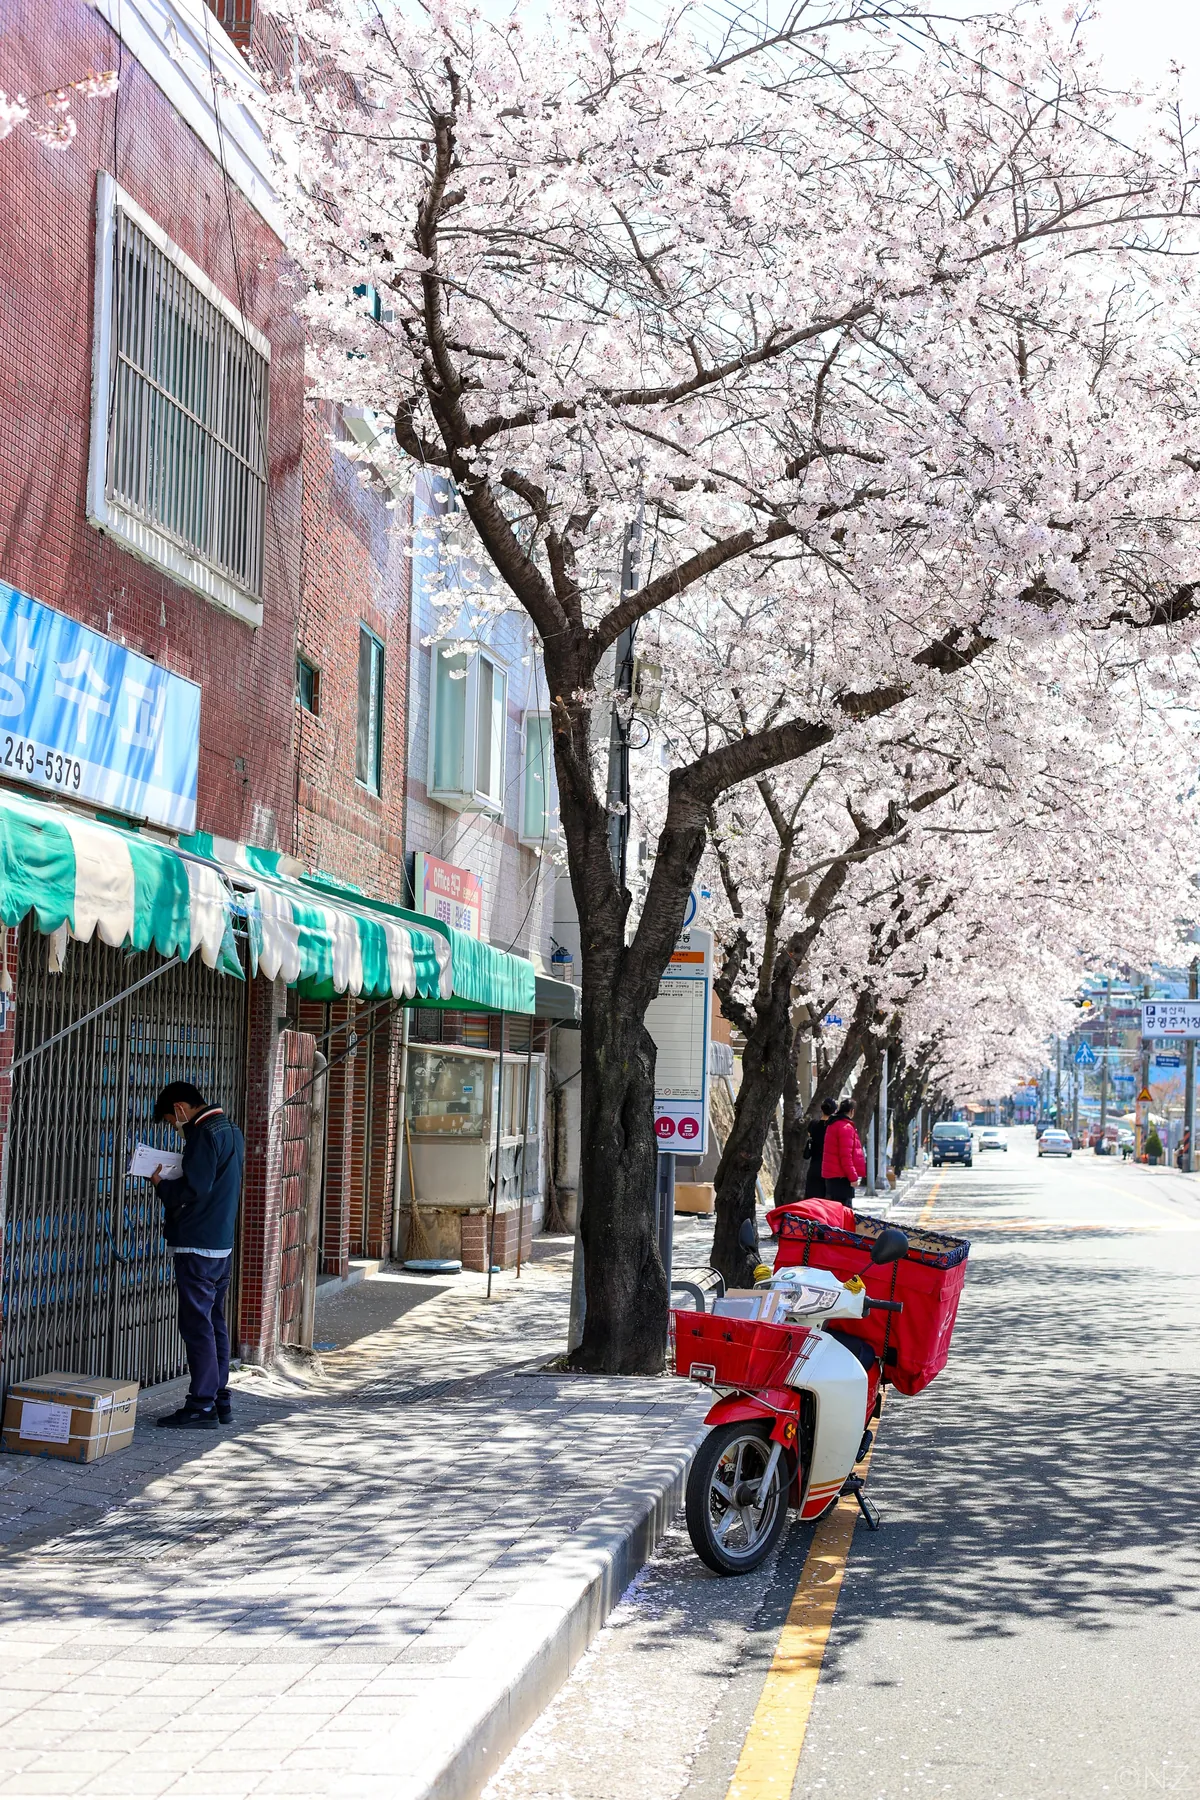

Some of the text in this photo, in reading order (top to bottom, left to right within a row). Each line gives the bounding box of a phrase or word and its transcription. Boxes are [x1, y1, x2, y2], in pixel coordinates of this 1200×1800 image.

[434, 867, 450, 892] Office
[661, 1124, 693, 1133] U S
